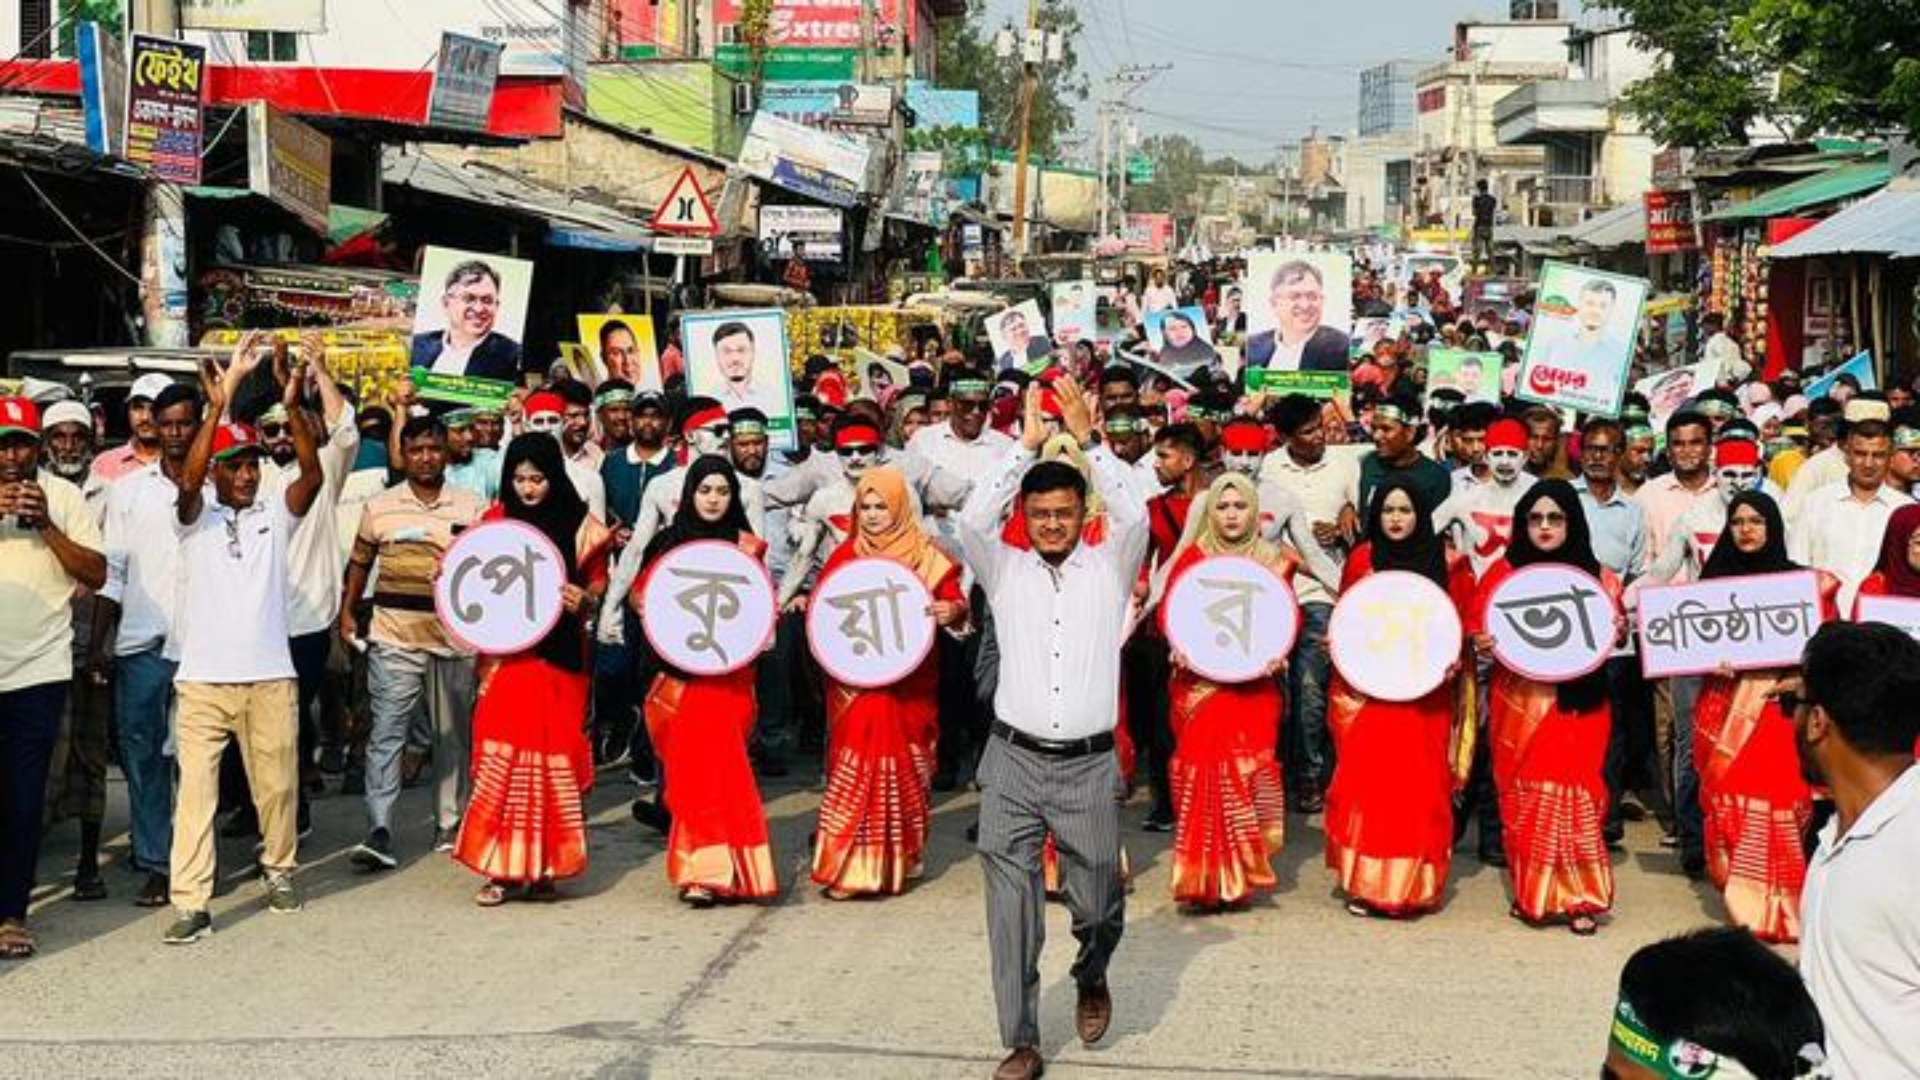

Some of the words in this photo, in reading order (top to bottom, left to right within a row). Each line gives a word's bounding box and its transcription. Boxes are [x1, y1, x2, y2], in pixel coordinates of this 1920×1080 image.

[450, 545, 548, 624] পে
[666, 566, 751, 665] কু
[824, 578, 910, 657] য়া
[1196, 578, 1269, 657] র
[1494, 584, 1599, 651] ভা
[1644, 592, 1814, 652] প্রতিষ্ঠাতা
